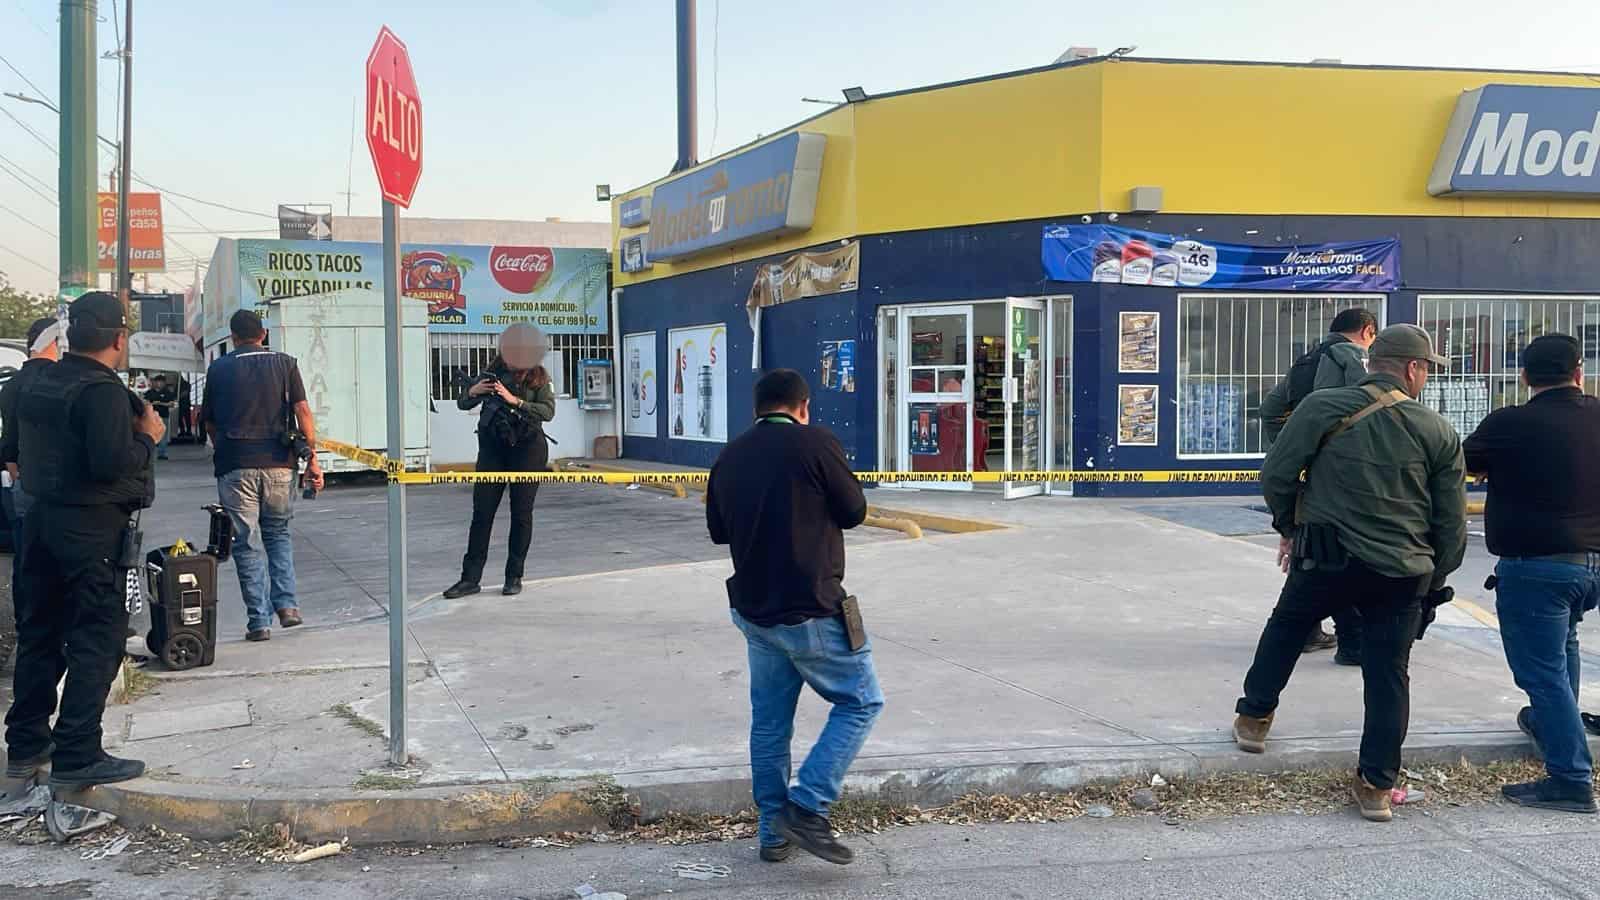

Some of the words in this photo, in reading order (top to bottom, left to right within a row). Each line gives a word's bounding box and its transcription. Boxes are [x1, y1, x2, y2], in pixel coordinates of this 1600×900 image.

[372, 76, 419, 161] ALTO
[129, 218, 158, 228] casa
[97, 240, 118, 259] 24
[269, 252, 312, 271] RICOS
[316, 254, 362, 272] TACOS
[494, 253, 549, 273] Coca-Cola
[1263, 266, 1277, 275] TE
[1279, 266, 1293, 275] LA
[1296, 264, 1353, 276] PONEMOS
[257, 279, 267, 297] Y
[502, 302, 534, 312] SERVICIO
[534, 303, 540, 312] A
[483, 315, 497, 325] TEL.
[538, 316, 553, 326] CEL.
[553, 316, 565, 326] 667
